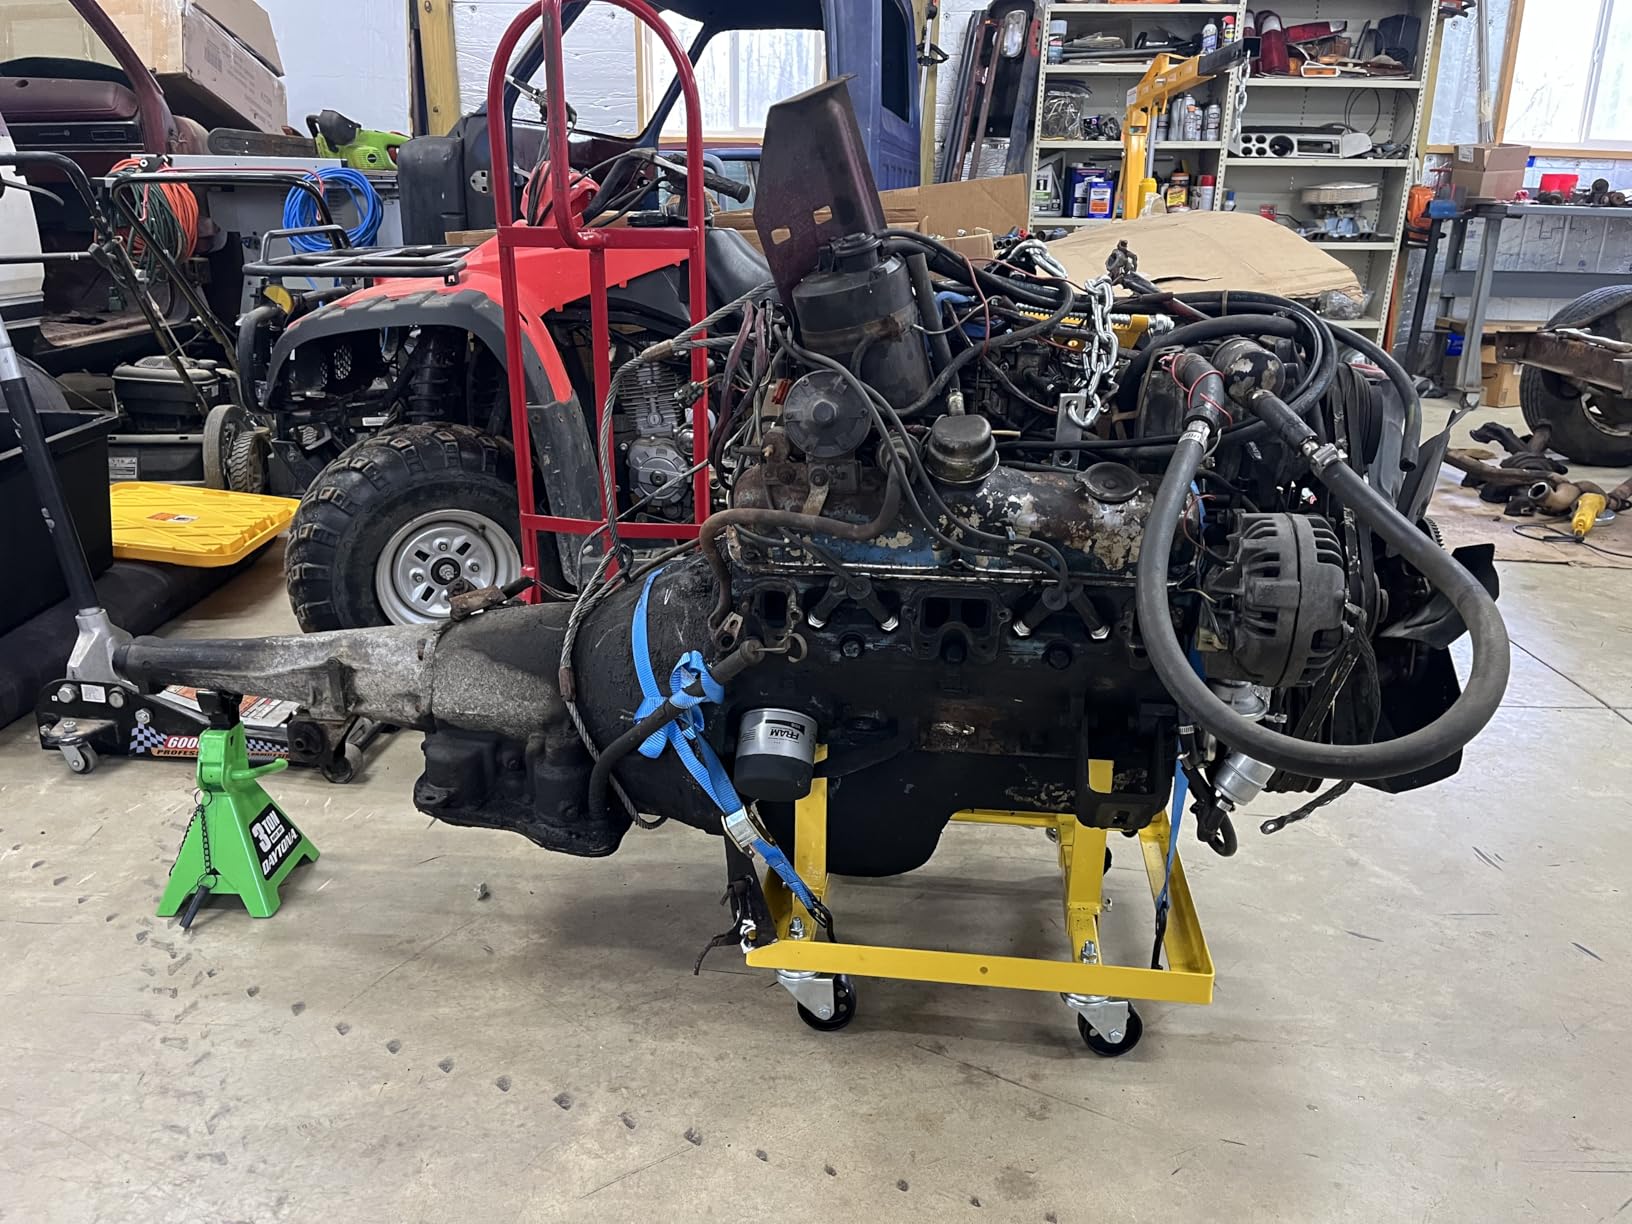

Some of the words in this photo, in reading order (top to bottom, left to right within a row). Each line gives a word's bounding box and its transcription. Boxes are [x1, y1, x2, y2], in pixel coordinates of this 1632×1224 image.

[167, 737, 200, 748] 600
[770, 728, 799, 740] FRAM
[261, 810, 280, 835] TON
[252, 822, 272, 852] 3
[262, 828, 298, 875] DAYTONA
